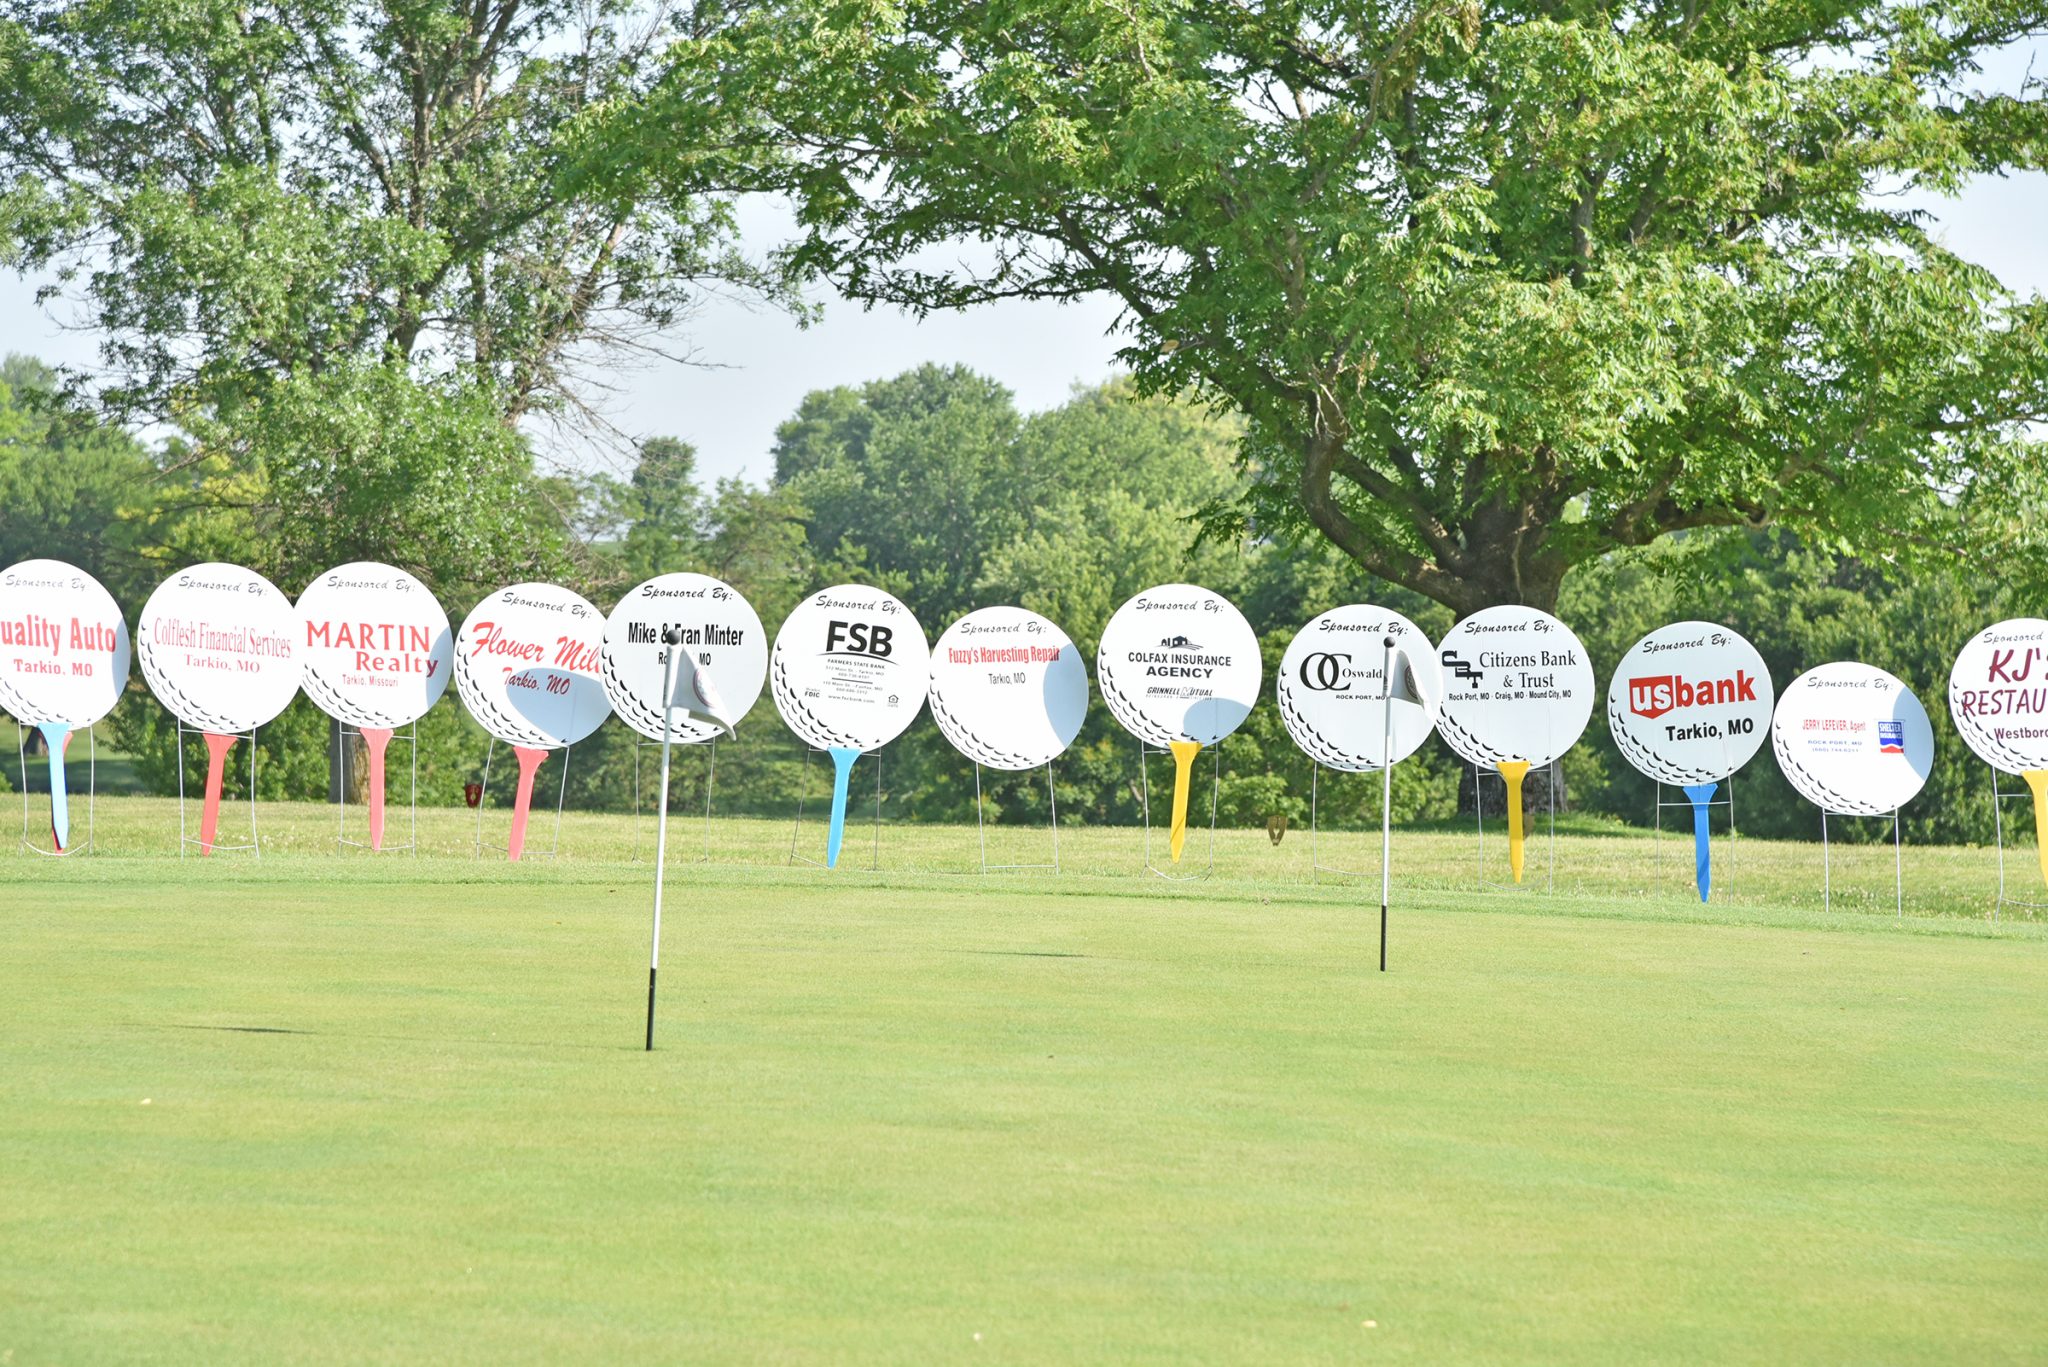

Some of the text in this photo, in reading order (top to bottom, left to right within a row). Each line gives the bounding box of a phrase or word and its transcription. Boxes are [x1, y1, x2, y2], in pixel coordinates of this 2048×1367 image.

[5, 574, 64, 588] Sponsored
[179, 575, 241, 592] Sponsored
[327, 575, 389, 591] Sponsored
[502, 592, 565, 612] Sponsored
[642, 585, 733, 602] Sponsored By:
[815, 595, 902, 615] Sponsored By:
[1136, 598, 1225, 614] Sponsored By:
[0, 614, 116, 657] uality Auto
[628, 622, 657, 644] Mike
[704, 624, 744, 646] Minter
[960, 622, 1021, 636] Sponsored
[1319, 619, 1409, 636] Sponsored By:
[1464, 619, 1554, 636] Sponsored By:
[154, 617, 291, 659] Colflesh Financial Services
[305, 620, 430, 653] MARTIN
[471, 621, 545, 662] Flower
[825, 620, 893, 658] FSB
[1643, 633, 1732, 654] Sponsored By:
[1983, 632, 2044, 645] Sponsored
[699, 652, 712, 666] MO
[827, 658, 853, 666] FARMERS
[948, 645, 1060, 665] Fuzzy's Harvesting Repair
[1128, 652, 1231, 667] COLFAX INSURANCE
[1479, 649, 1577, 668] Citizens Bank
[72, 662, 93, 677] MO
[237, 659, 260, 673] MO
[356, 651, 438, 678] Realty
[1146, 666, 1214, 679] AGENCY
[1342, 667, 1383, 679] Oswald
[546, 674, 572, 695] MO
[1013, 672, 1026, 684] MO
[1503, 672, 1554, 688] & Trust
[1807, 676, 1868, 690] Sponsored
[1147, 686, 1180, 695] GRINNELL
[1448, 689, 1572, 701] Rock Port, MO Craig, MO Mound City, MO
[1962, 688, 2048, 717] RESTAU
[1666, 717, 1754, 742] Tarkio, MO
[1802, 719, 1820, 730] JERRY
[1850, 720, 1866, 733] Agent
